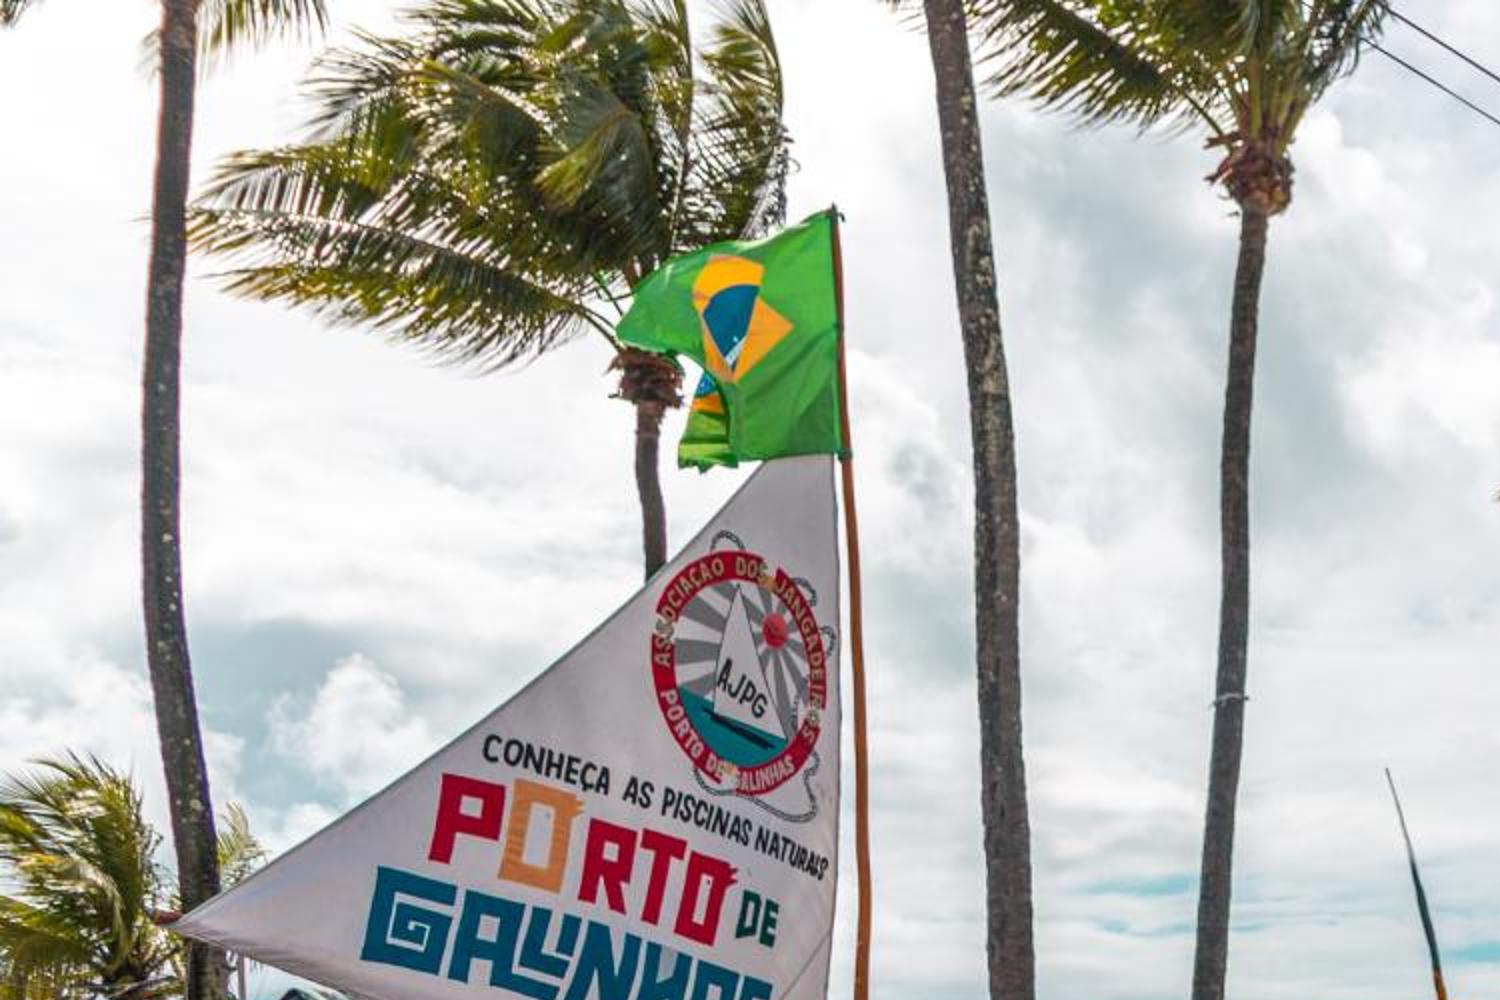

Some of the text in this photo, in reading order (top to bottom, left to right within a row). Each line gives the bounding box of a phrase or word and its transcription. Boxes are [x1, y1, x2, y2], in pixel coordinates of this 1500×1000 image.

[735, 557, 769, 581] DOS
[717, 657, 767, 719] AJPG
[660, 690, 704, 758] PORTO
[482, 734, 830, 881] CONHEÇA AS PISCINAS NATURAIS
[428, 772, 779, 947] PORTO DE
